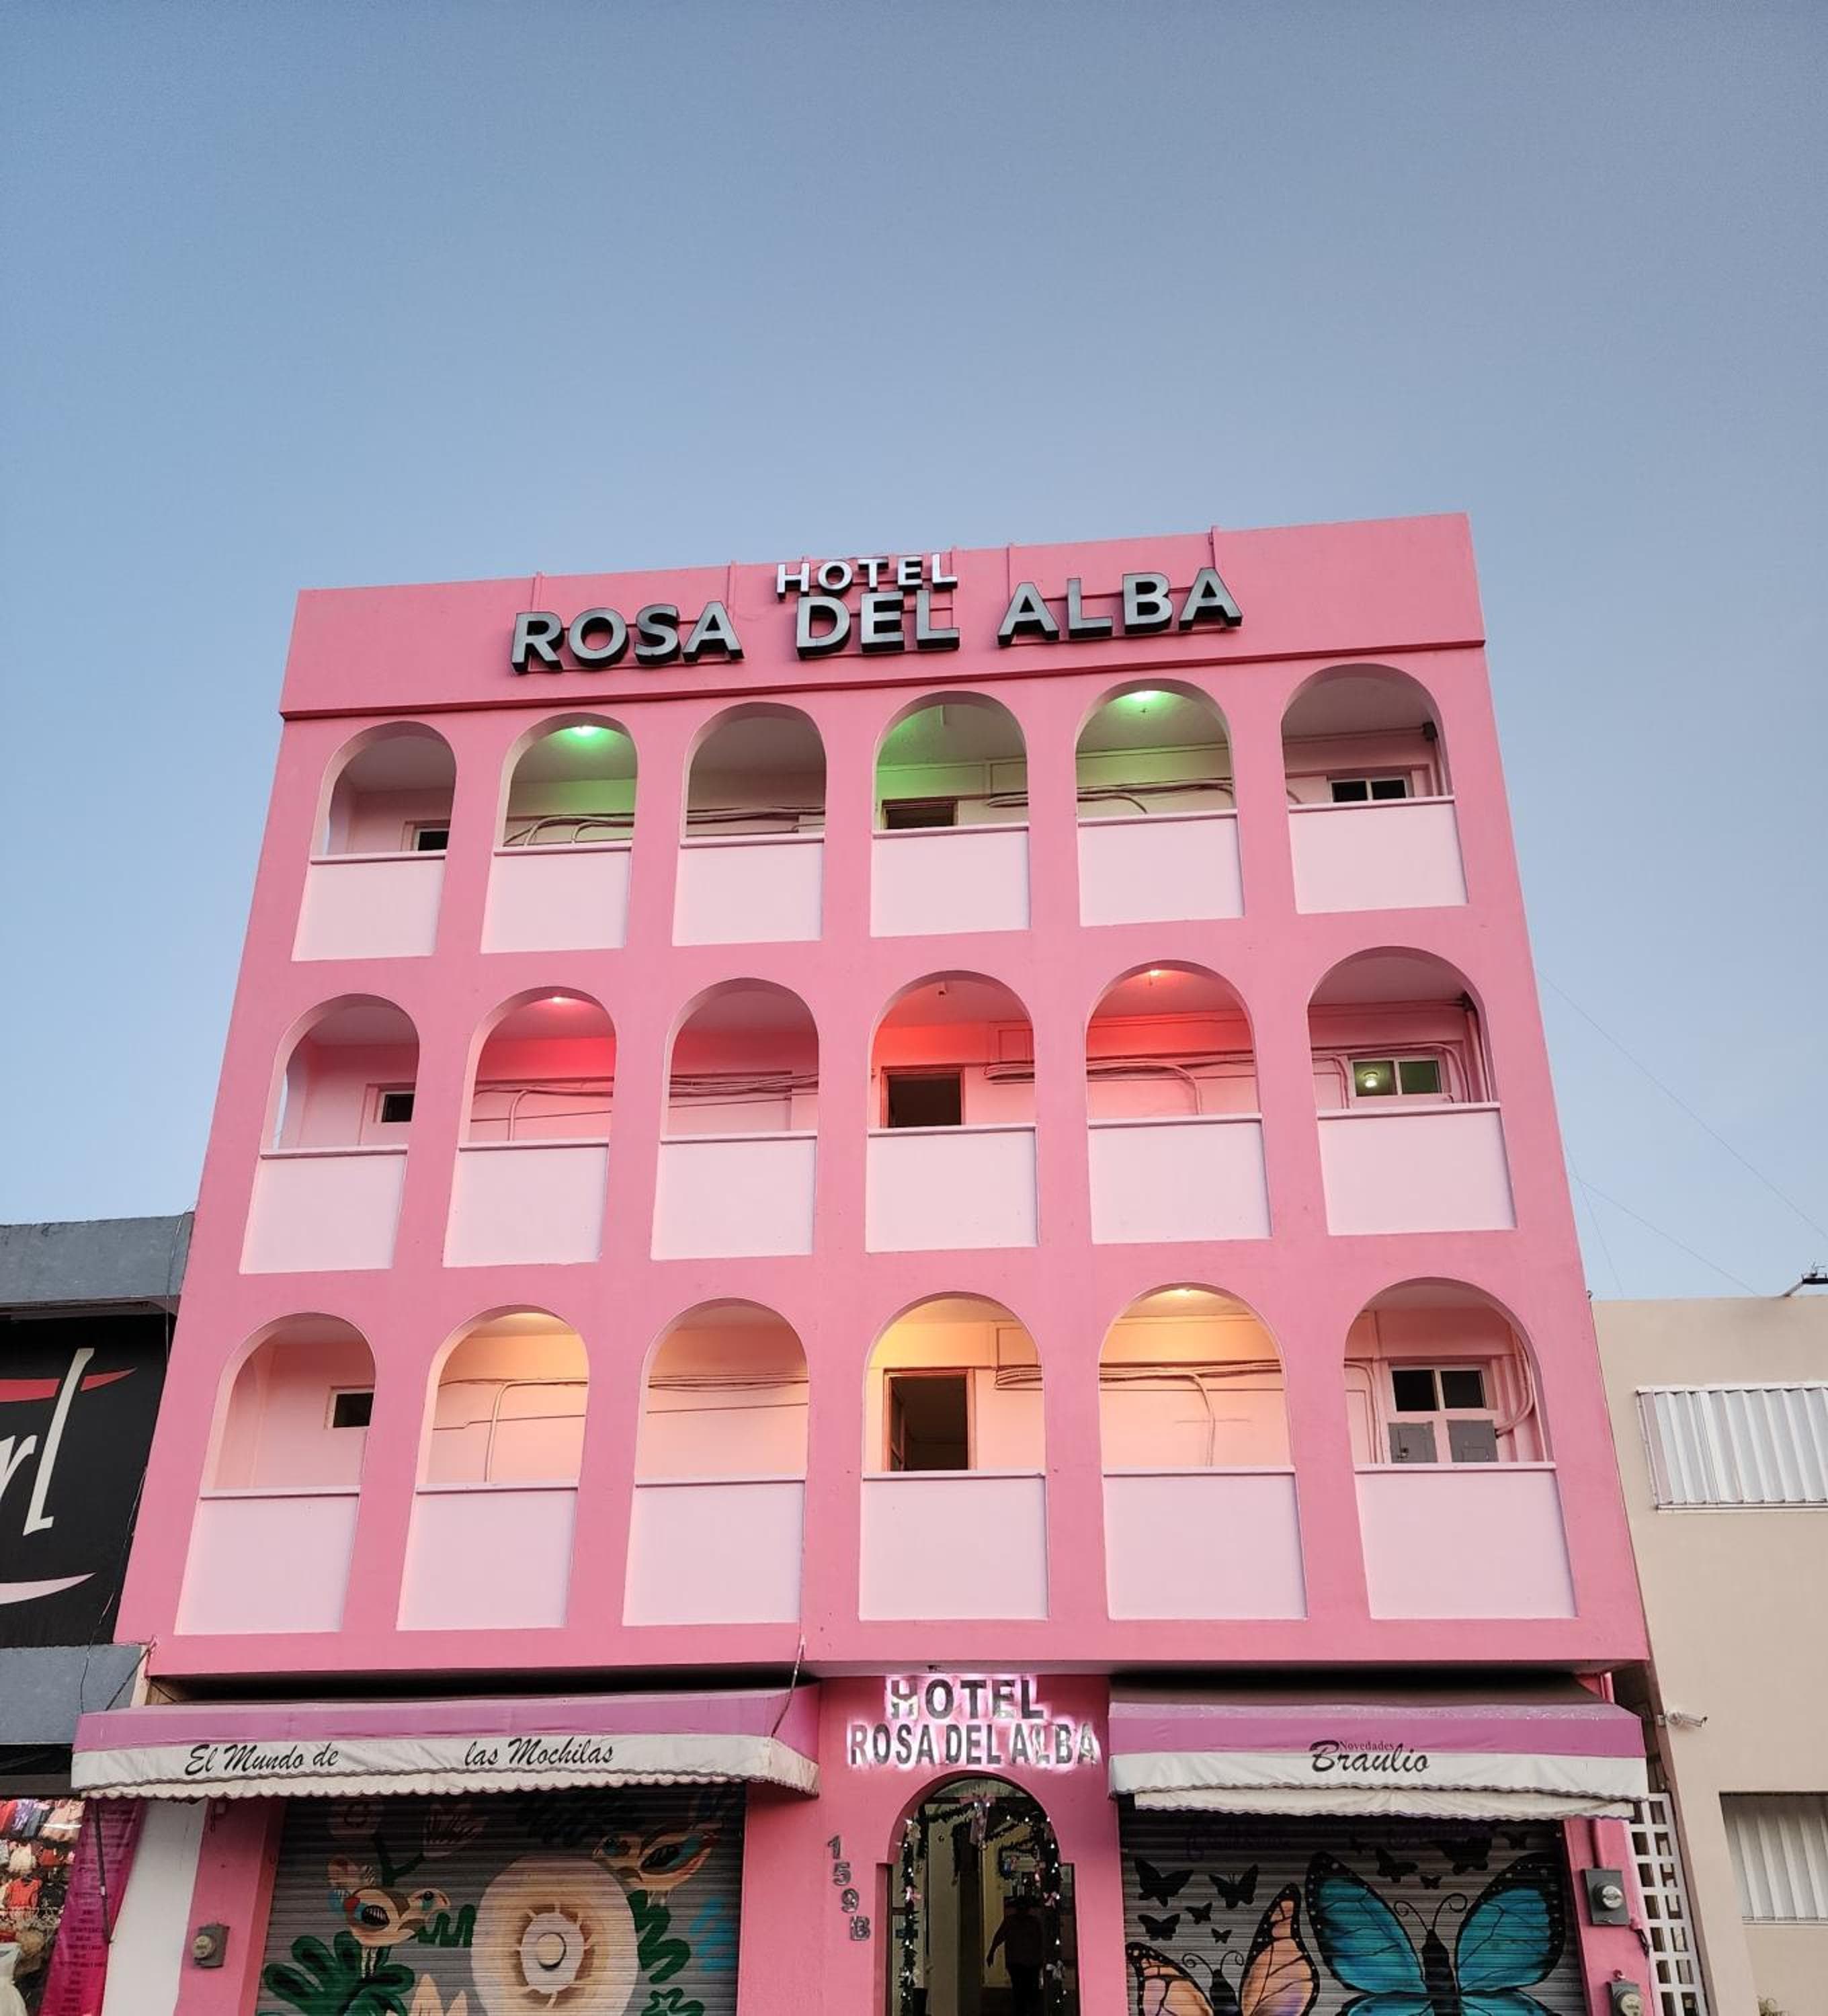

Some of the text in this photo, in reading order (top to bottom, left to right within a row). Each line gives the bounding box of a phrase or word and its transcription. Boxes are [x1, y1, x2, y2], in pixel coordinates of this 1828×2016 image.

[776, 553, 958, 601] HOTEL
[511, 566, 1243, 674] ROSA DEL ALBA
[890, 1678, 1044, 1720] HOTEL
[184, 1736, 614, 1775] El Mundo de las Mochilas
[850, 1722, 1097, 1765] ROSA DEL ALBA
[1309, 1740, 1430, 1772] Braulio
[1339, 1740, 1395, 1751] Novedades
